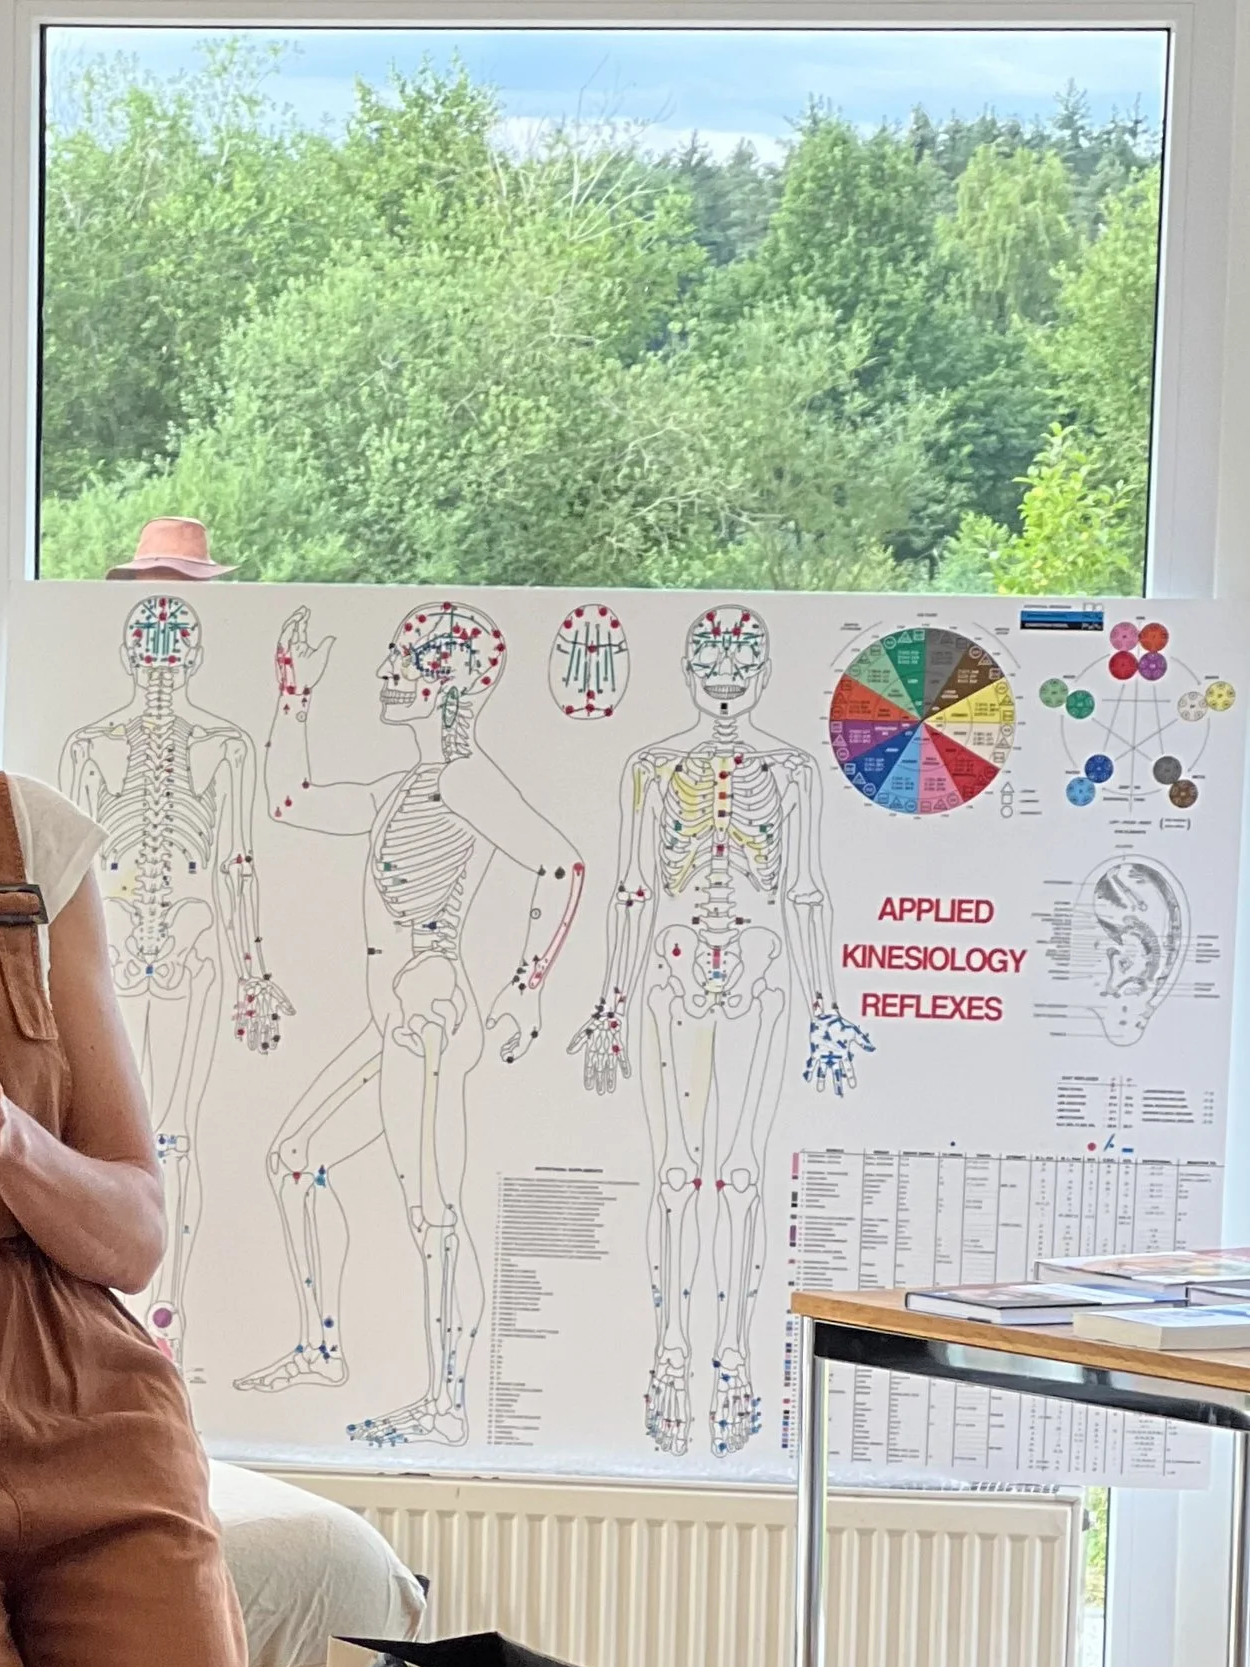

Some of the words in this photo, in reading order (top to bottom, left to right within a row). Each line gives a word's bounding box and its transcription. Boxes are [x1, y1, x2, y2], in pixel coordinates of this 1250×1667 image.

[878, 897, 995, 924] APPLIED
[842, 944, 1027, 973] KINESIOLOGY
[861, 993, 1003, 1021] REFLEXES
